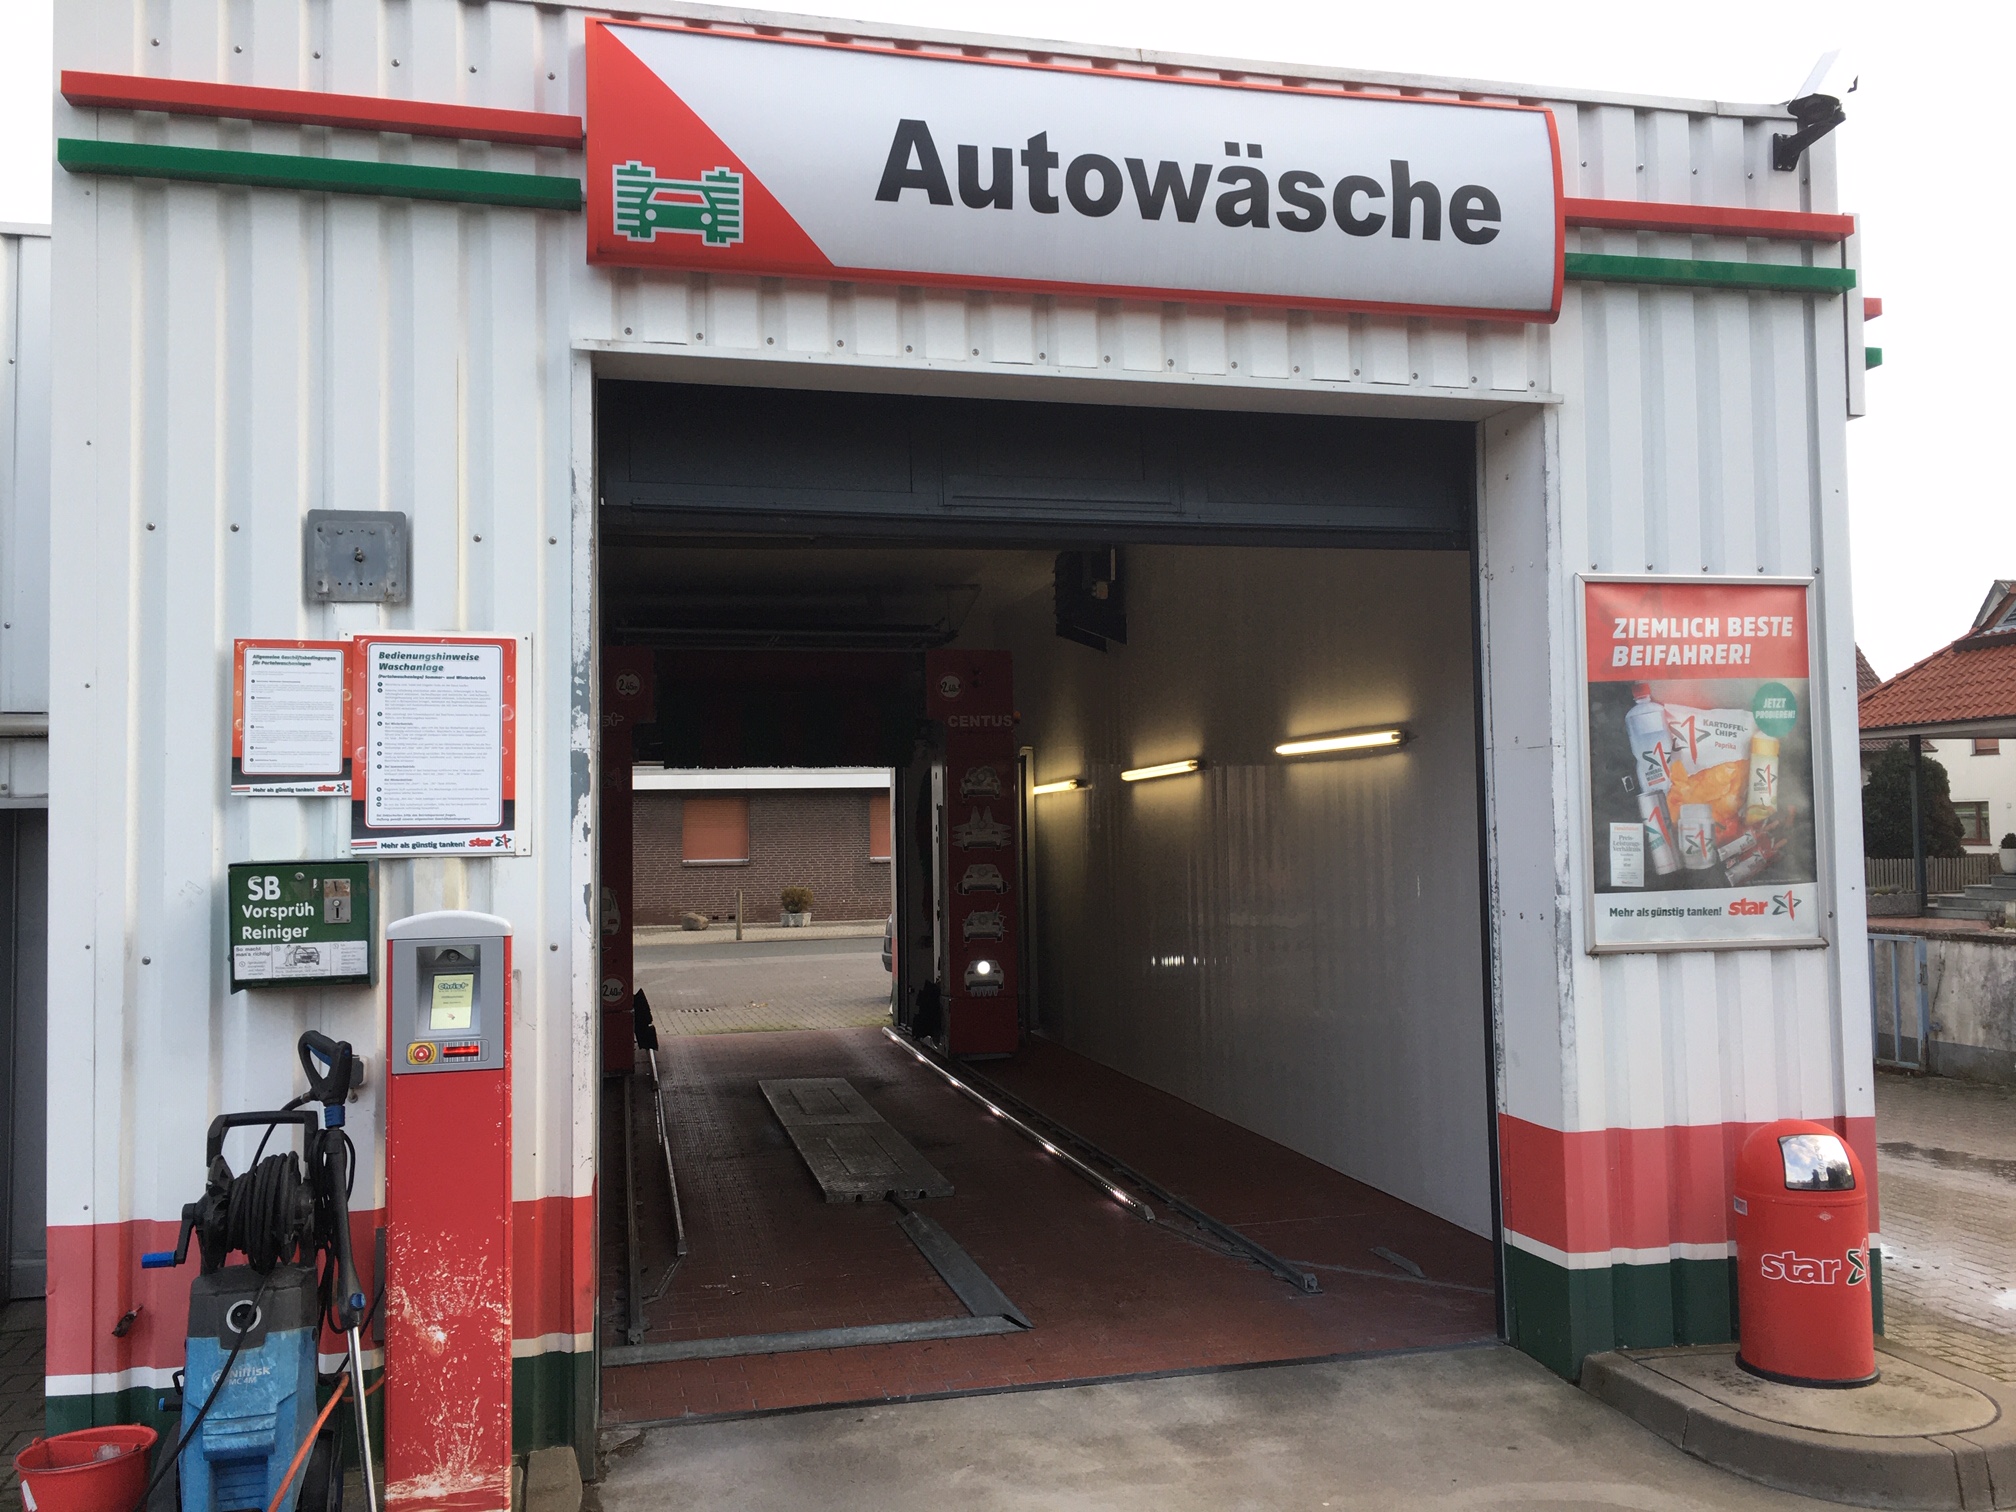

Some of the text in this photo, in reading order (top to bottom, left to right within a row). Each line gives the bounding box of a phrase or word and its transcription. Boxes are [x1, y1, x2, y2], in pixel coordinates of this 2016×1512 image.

[875, 118, 1503, 246] Autowäsche
[1612, 616, 1793, 639] ZIEMLICH BESTE
[378, 651, 480, 661] Bedienungshinweise
[1612, 643, 1751, 667] BEIFAHRER!
[378, 662, 444, 672] Waschanlage
[1763, 697, 1787, 709] JETZT
[947, 715, 1013, 728] CENTUS
[1714, 741, 1737, 750] Paprika
[412, 841, 437, 850] günstig
[439, 840, 465, 848] tanken!
[468, 837, 494, 847] star
[247, 875, 281, 901] SB
[241, 901, 315, 921] Vorsprüh
[1609, 897, 1768, 918] Mehr als günstig tanken! star
[242, 924, 309, 942] Reiniger
[438, 982, 466, 991] Christ
[1761, 1250, 1842, 1285] star
[229, 1366, 271, 1378] Nilfisk
